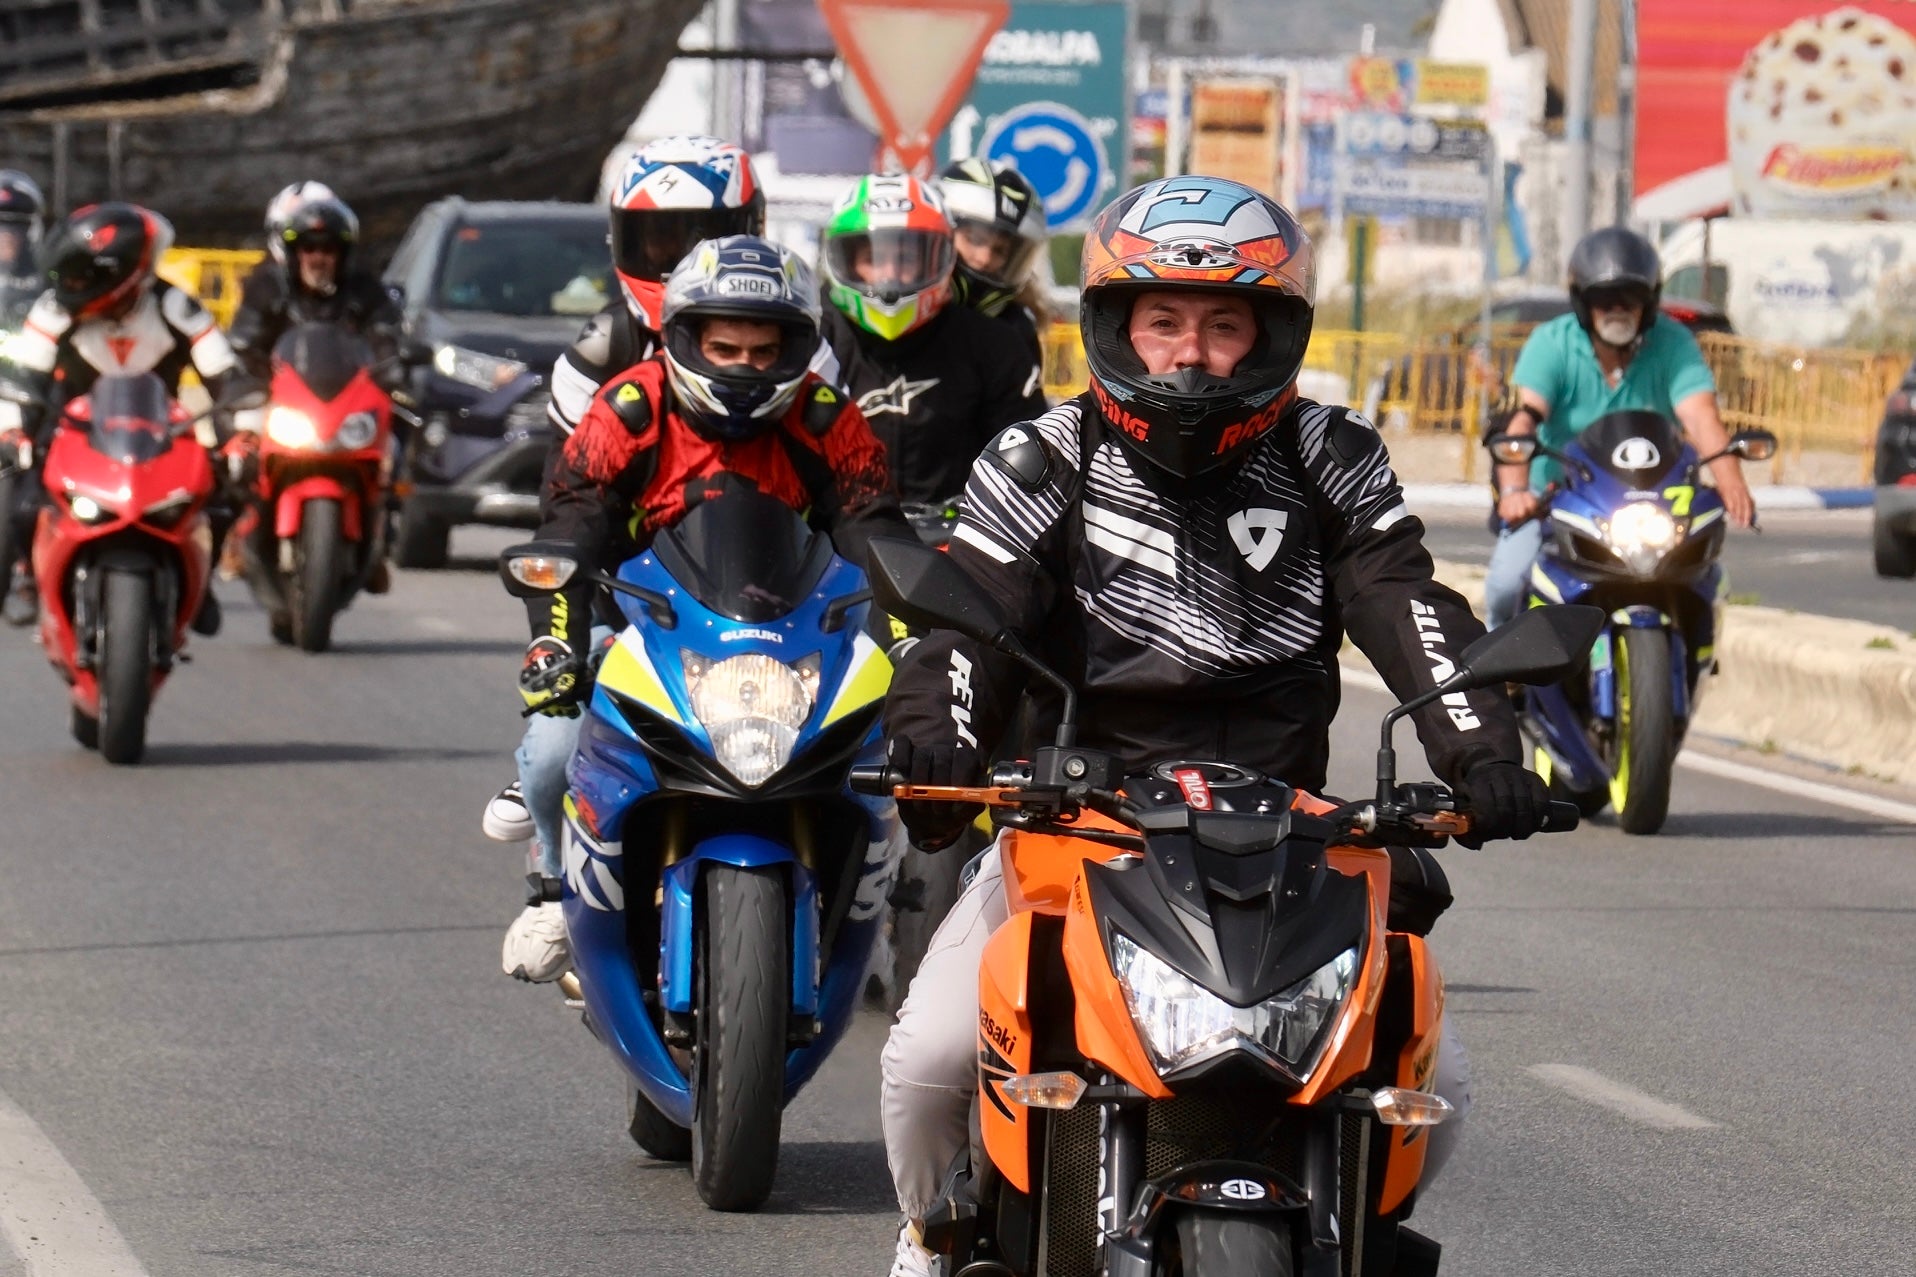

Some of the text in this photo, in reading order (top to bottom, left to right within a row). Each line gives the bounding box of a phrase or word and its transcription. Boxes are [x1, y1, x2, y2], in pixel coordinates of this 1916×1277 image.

[728, 279, 772, 295] SHOEI
[720, 629, 783, 643] SUZUKI
[980, 1008, 1017, 1056] asaki
